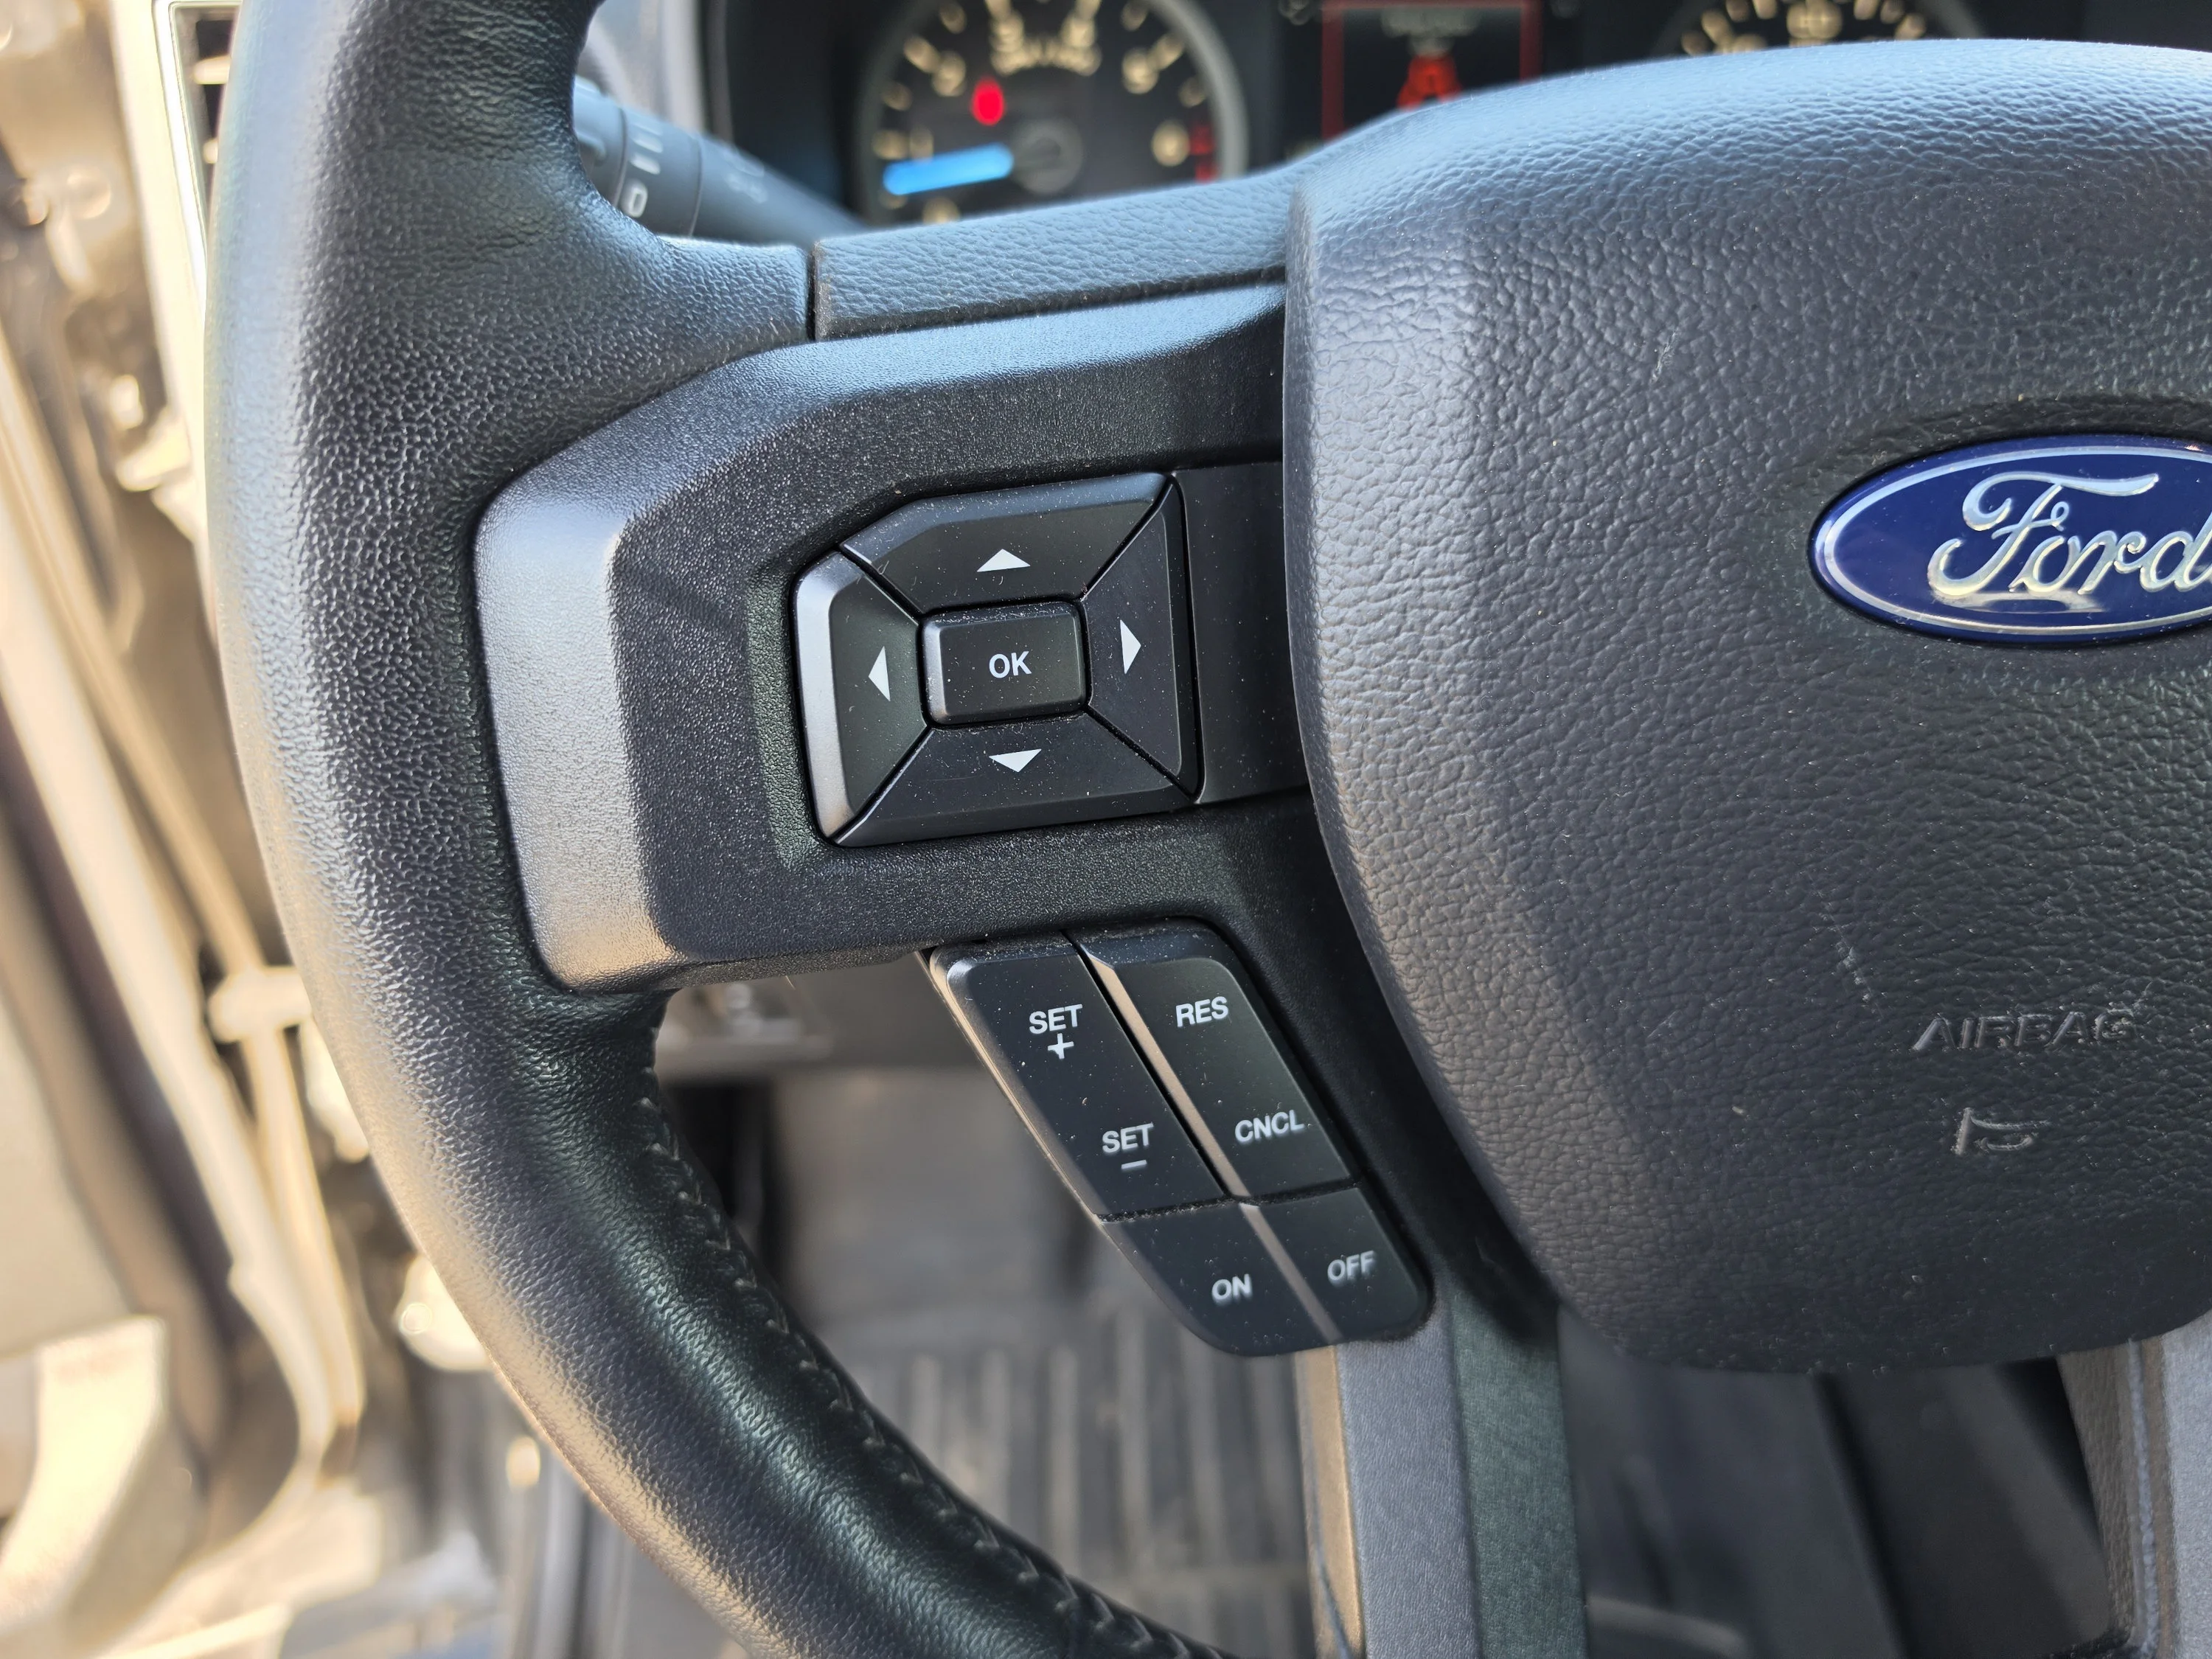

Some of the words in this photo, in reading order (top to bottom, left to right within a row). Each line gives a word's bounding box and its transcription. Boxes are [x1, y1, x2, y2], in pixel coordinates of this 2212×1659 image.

[1928, 470, 2212, 599] Ford
[989, 650, 1032, 678] OK
[1029, 1004, 1083, 1034] SET
[1175, 995, 1229, 1028] RES
[1913, 1009, 2136, 1051] AIRBAG
[1102, 1122, 1154, 1154] SET
[1234, 1109, 1305, 1144] CNCL
[1327, 1250, 1376, 1283] OFF
[1211, 1273, 1252, 1305] ON
